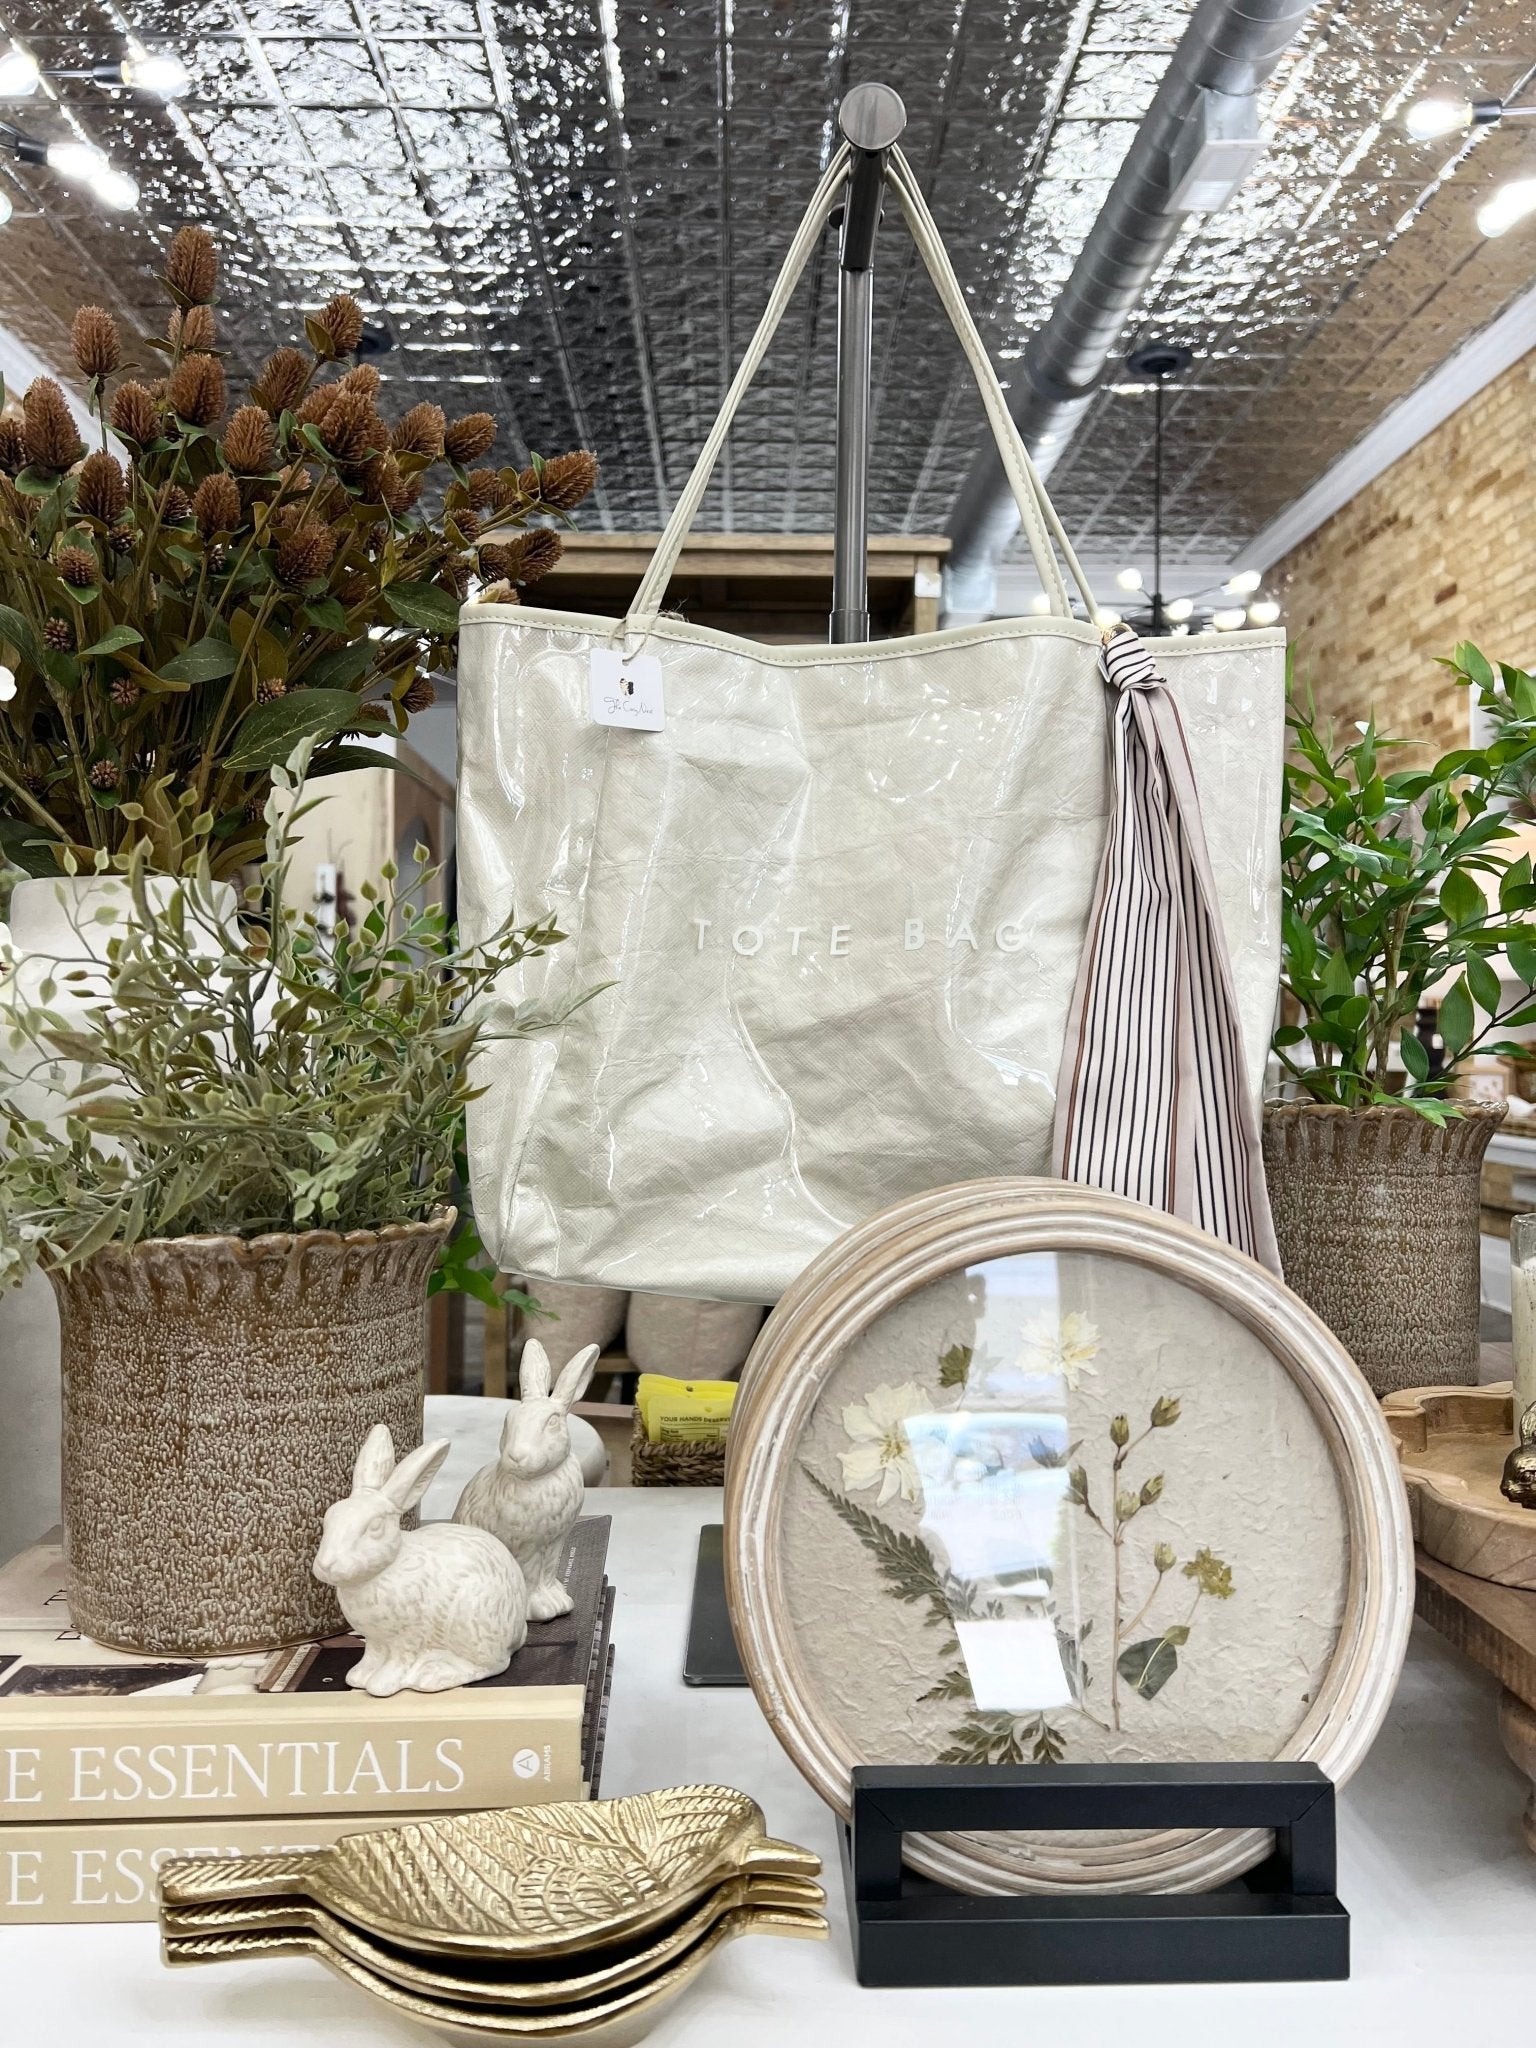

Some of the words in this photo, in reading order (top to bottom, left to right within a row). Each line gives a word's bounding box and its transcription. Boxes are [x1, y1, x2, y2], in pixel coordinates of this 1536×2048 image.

[692, 918, 851, 956] TOTE
[904, 918, 1031, 953] BAG
[68, 1737, 466, 1801] ESSENTIALS
